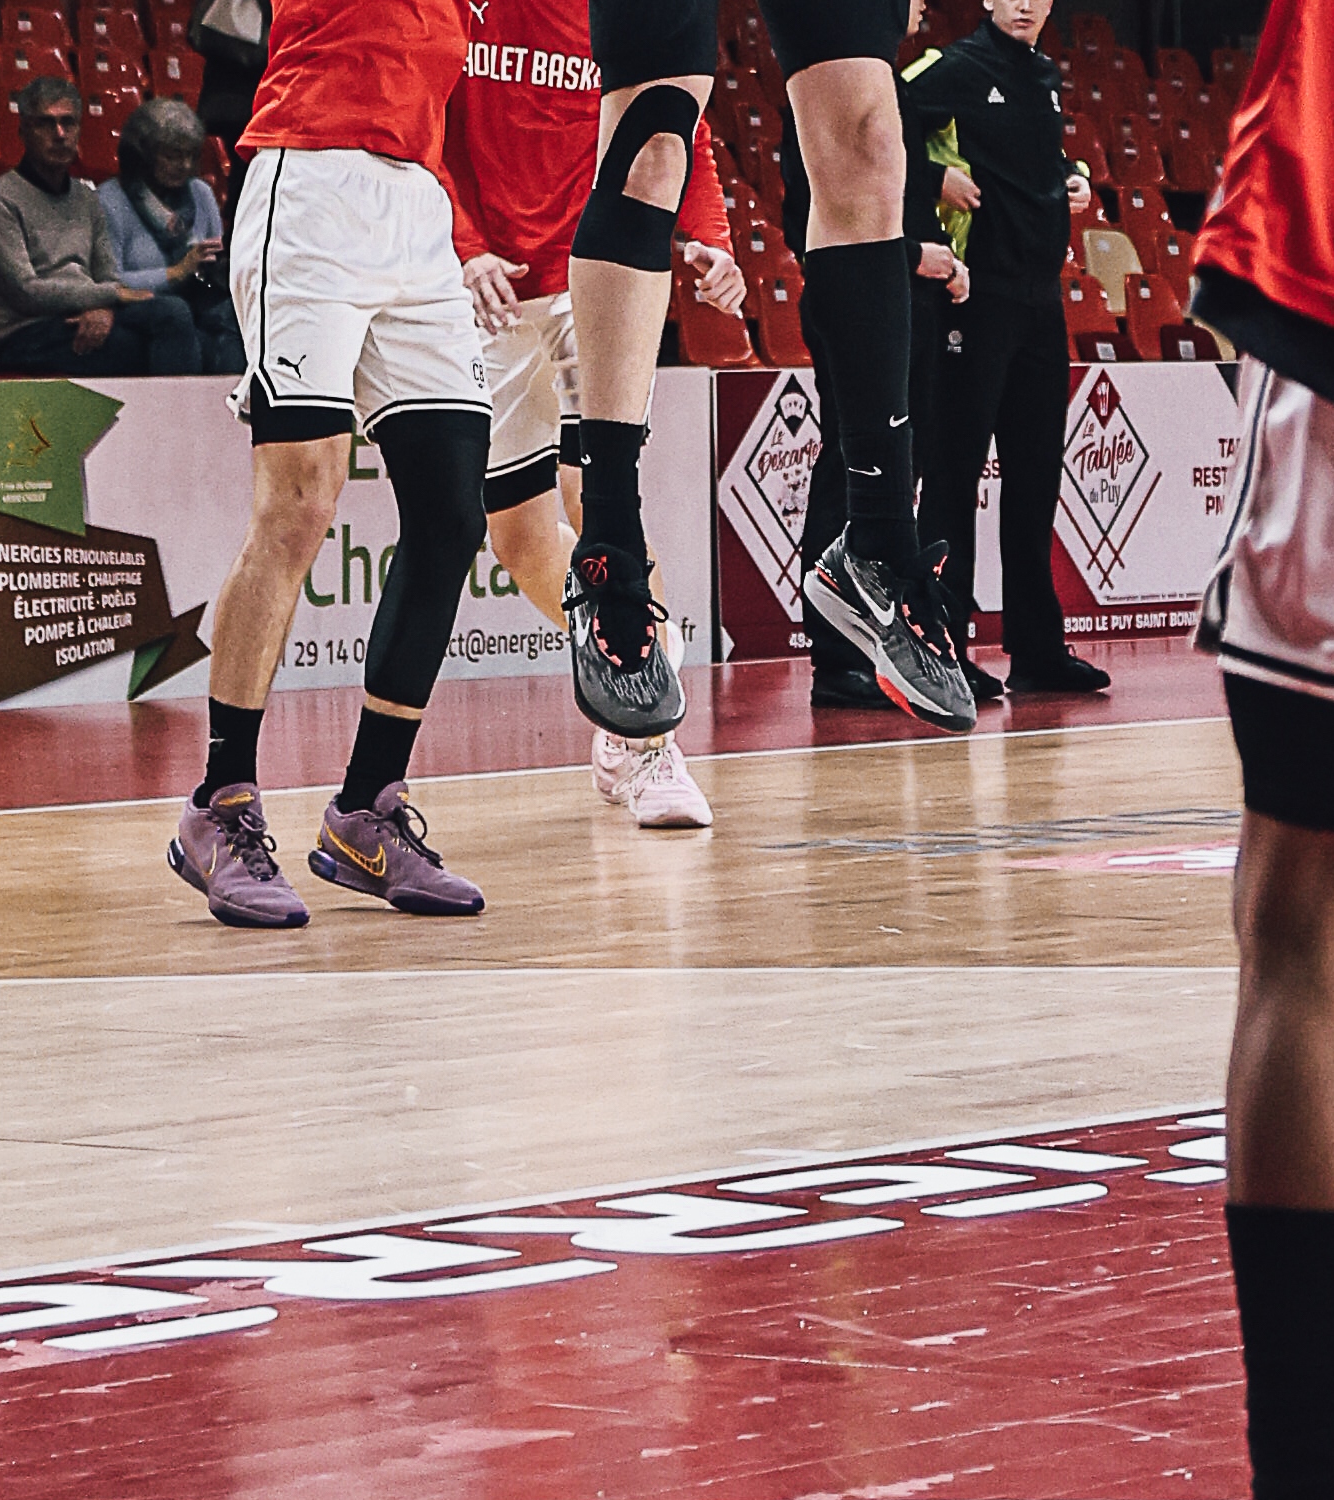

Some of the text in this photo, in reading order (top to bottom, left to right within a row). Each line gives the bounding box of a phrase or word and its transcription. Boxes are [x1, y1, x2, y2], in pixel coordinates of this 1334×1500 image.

[463, 42, 529, 82] HOLET
[1219, 438, 1240, 458] TA
[1193, 467, 1227, 487] REST
[1100, 479, 1121, 506] Puy
[14, 592, 95, 620] ÉLECTRICITÉ
[25, 624, 75, 646] POMPE
[87, 612, 133, 634] CHALEUR
[1095, 614, 1108, 631] LE
[1111, 613, 1132, 630] PUY
[1136, 612, 1167, 629] SAINT
[56, 637, 116, 666] ISOLATION
[295, 640, 318, 664] 29
[327, 638, 348, 663] 14
